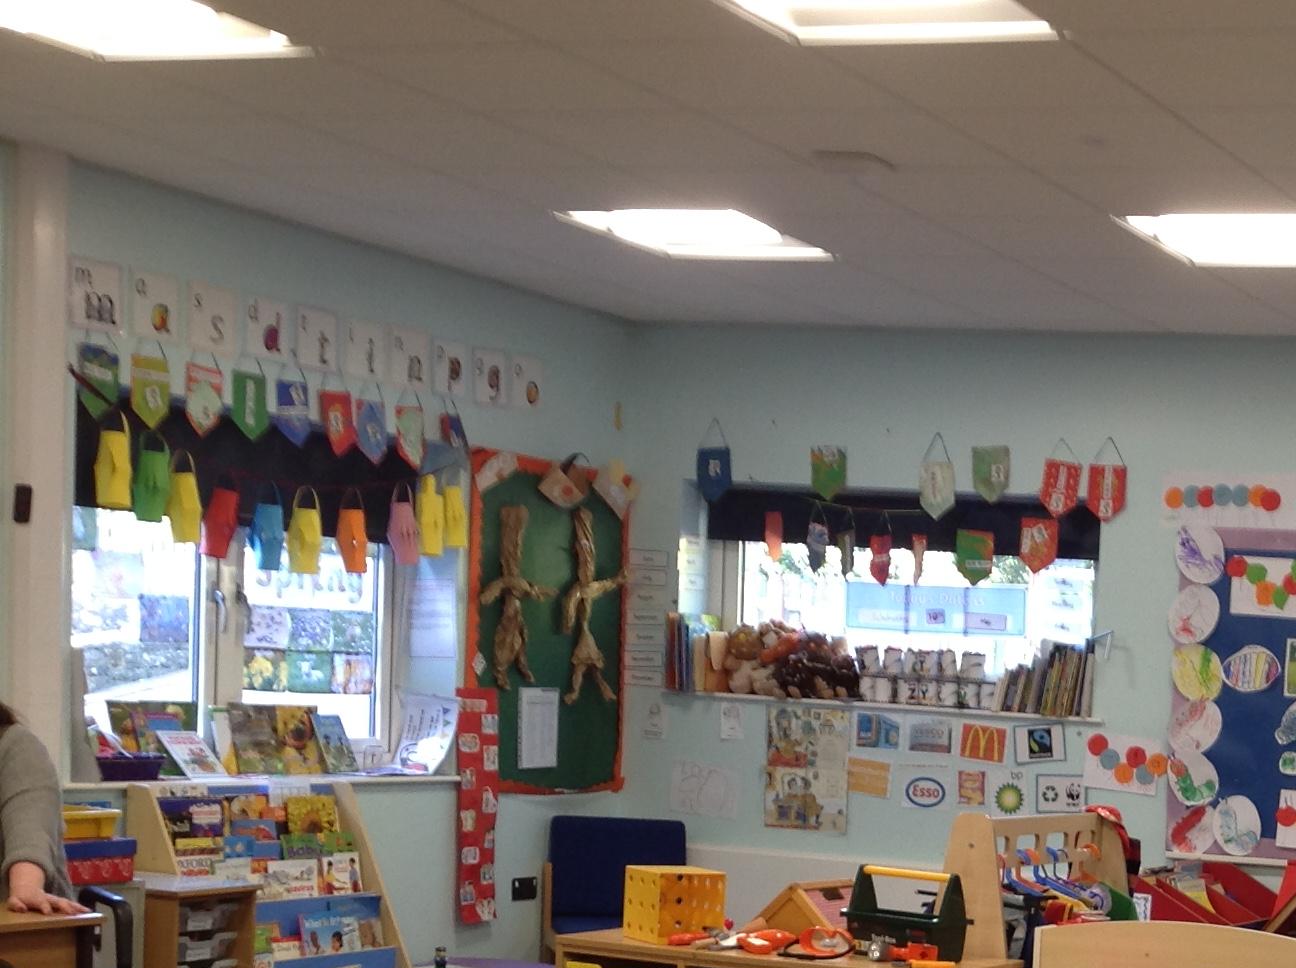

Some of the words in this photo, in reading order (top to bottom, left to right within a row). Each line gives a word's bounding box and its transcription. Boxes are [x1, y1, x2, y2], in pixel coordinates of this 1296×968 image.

[84, 291, 115, 325] m
[152, 303, 171, 334] a
[210, 314, 224, 344] s
[263, 309, 281, 352] d
[448, 357, 461, 390] p
[488, 365, 500, 400] g
[912, 784, 940, 798] Esso
[1010, 771, 1023, 780] bp
